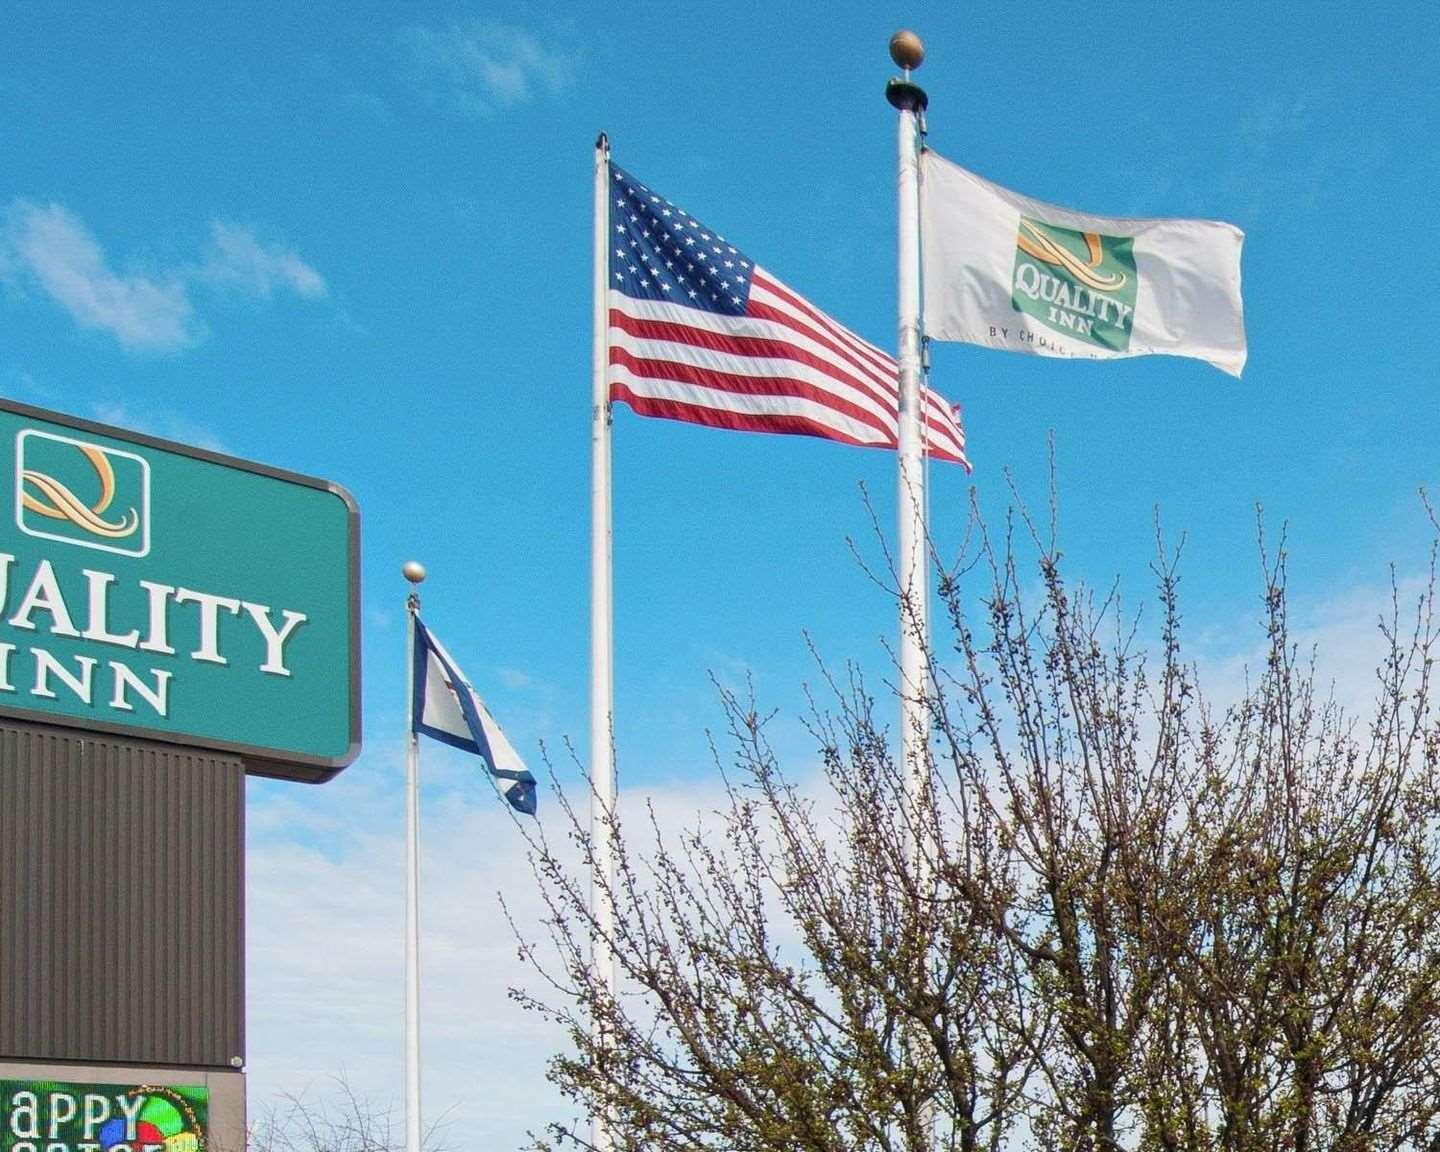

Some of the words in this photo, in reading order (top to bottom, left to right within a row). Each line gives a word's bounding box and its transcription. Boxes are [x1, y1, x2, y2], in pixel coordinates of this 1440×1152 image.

[1015, 262, 1133, 330] QUALITY
[1047, 306, 1095, 337] INN
[989, 326, 1009, 338] BY
[0, 553, 308, 676] ALITY
[0, 643, 173, 717] INN
